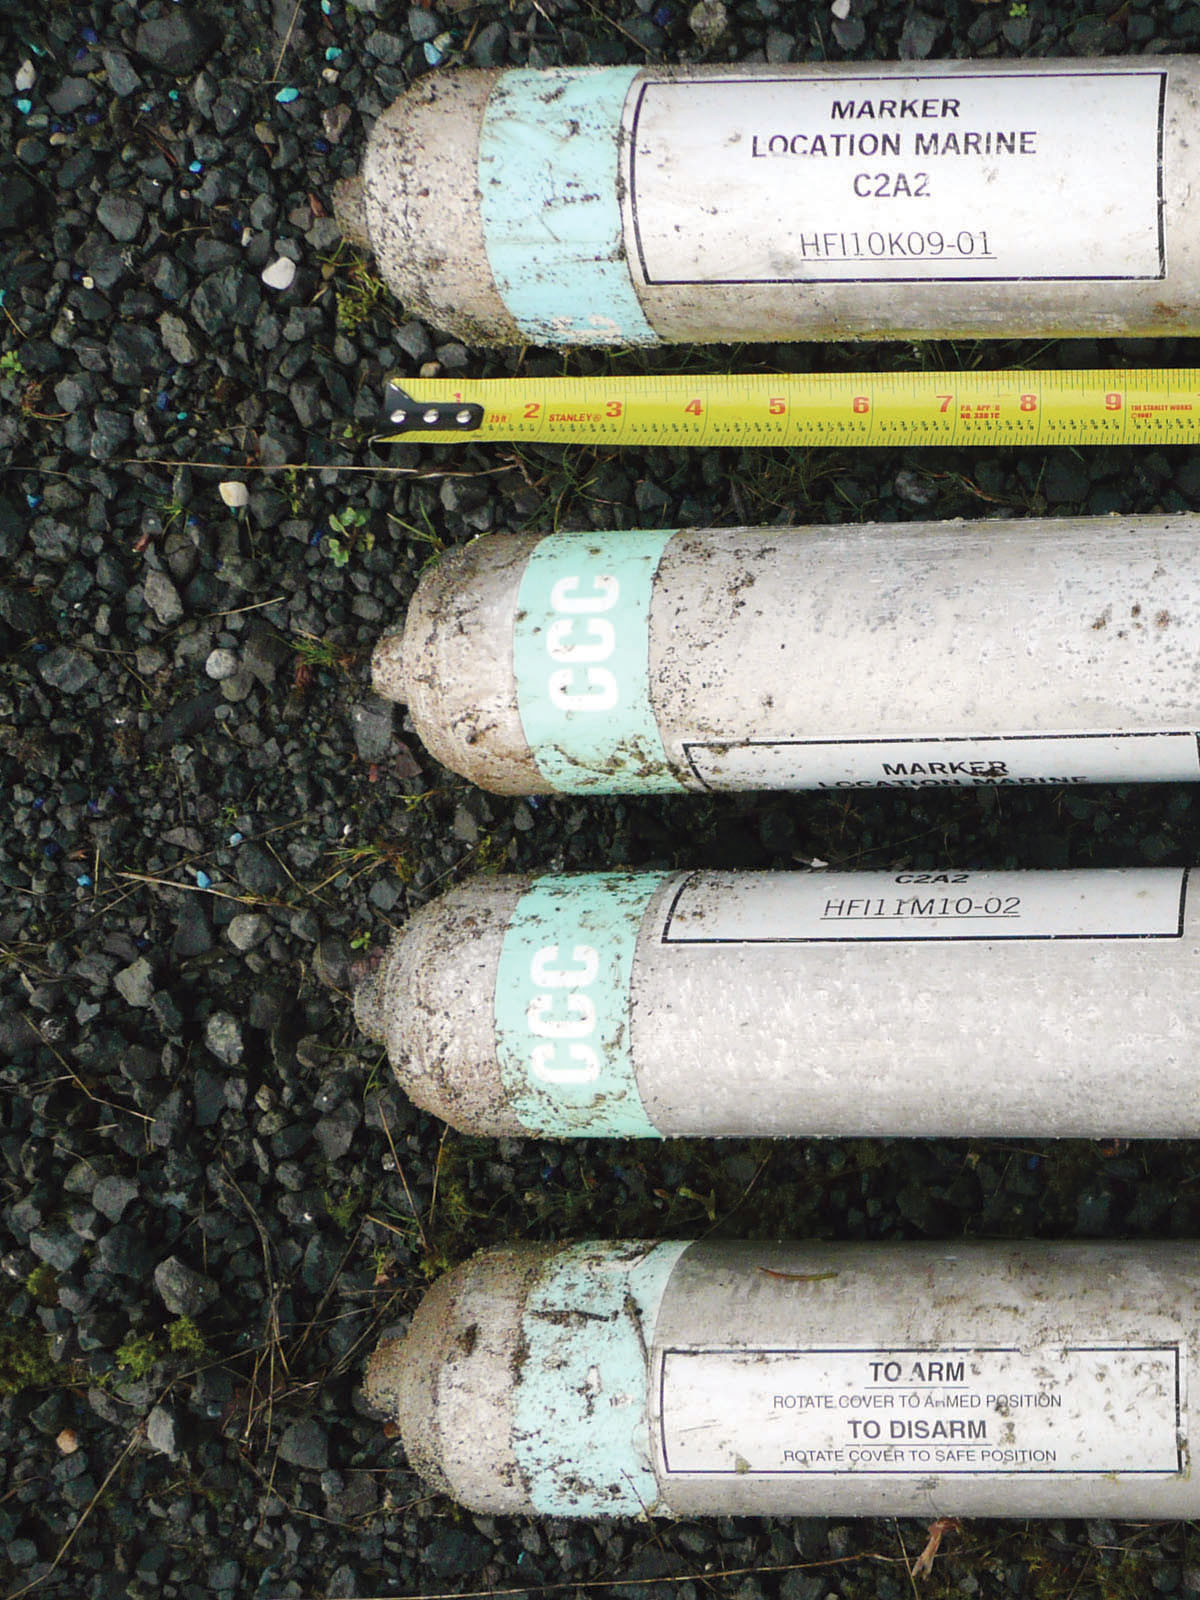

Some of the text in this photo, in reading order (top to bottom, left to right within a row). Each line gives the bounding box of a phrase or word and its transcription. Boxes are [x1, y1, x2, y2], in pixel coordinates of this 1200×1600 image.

[831, 98, 961, 120] MARKER
[751, 131, 1037, 158] LOCATION MARINE
[853, 173, 931, 198] C2A2
[523, 403, 541, 419] 2
[606, 401, 622, 418] 3
[685, 399, 704, 416] 4
[769, 398, 786, 415] 5
[853, 396, 870, 414] 6
[936, 395, 953, 412] 7
[1020, 394, 1037, 412] 8
[1105, 393, 1122, 411] 9
[547, 575, 620, 712] CCC
[882, 760, 1009, 778] MARKER
[894, 873, 970, 884] C2A2
[527, 944, 600, 1084] CCC
[869, 1361, 966, 1382] TO ARM
[773, 1395, 834, 1409] ROTATE
[838, 1395, 894, 1409] COVER
[899, 1394, 920, 1408] TO
[986, 1393, 1062, 1408] POSITION
[847, 1420, 987, 1439] TO DISARM
[784, 1450, 1057, 1463] ROTATE COVER TO SAFE POSITION
